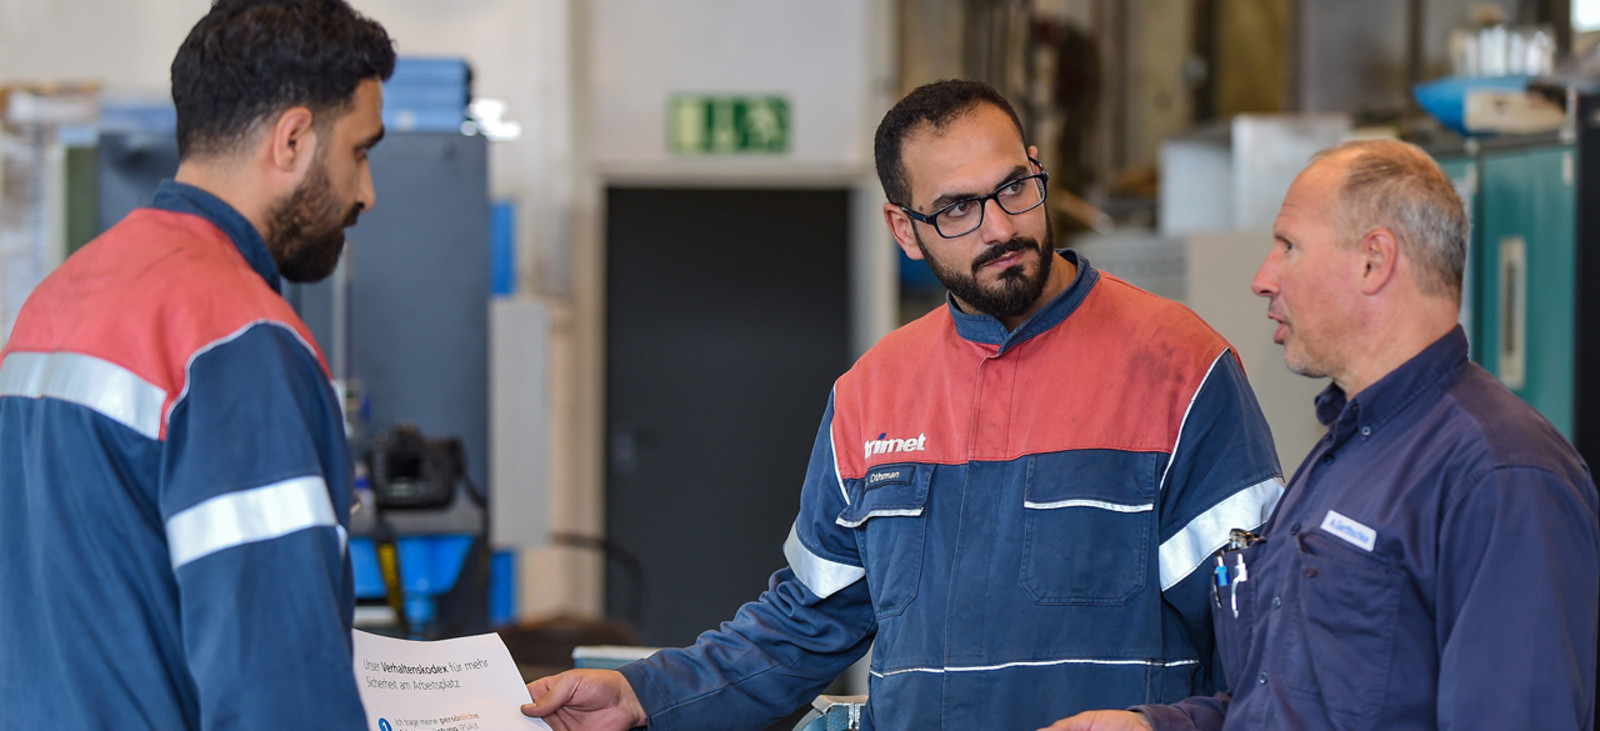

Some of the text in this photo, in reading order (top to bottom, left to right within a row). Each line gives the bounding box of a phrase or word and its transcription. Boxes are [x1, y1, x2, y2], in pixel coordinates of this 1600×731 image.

[363, 658, 489, 675] Unser Verhaltenskodex für mehr
[365, 675, 461, 691] Sicherheit am Arbeitsplatz
